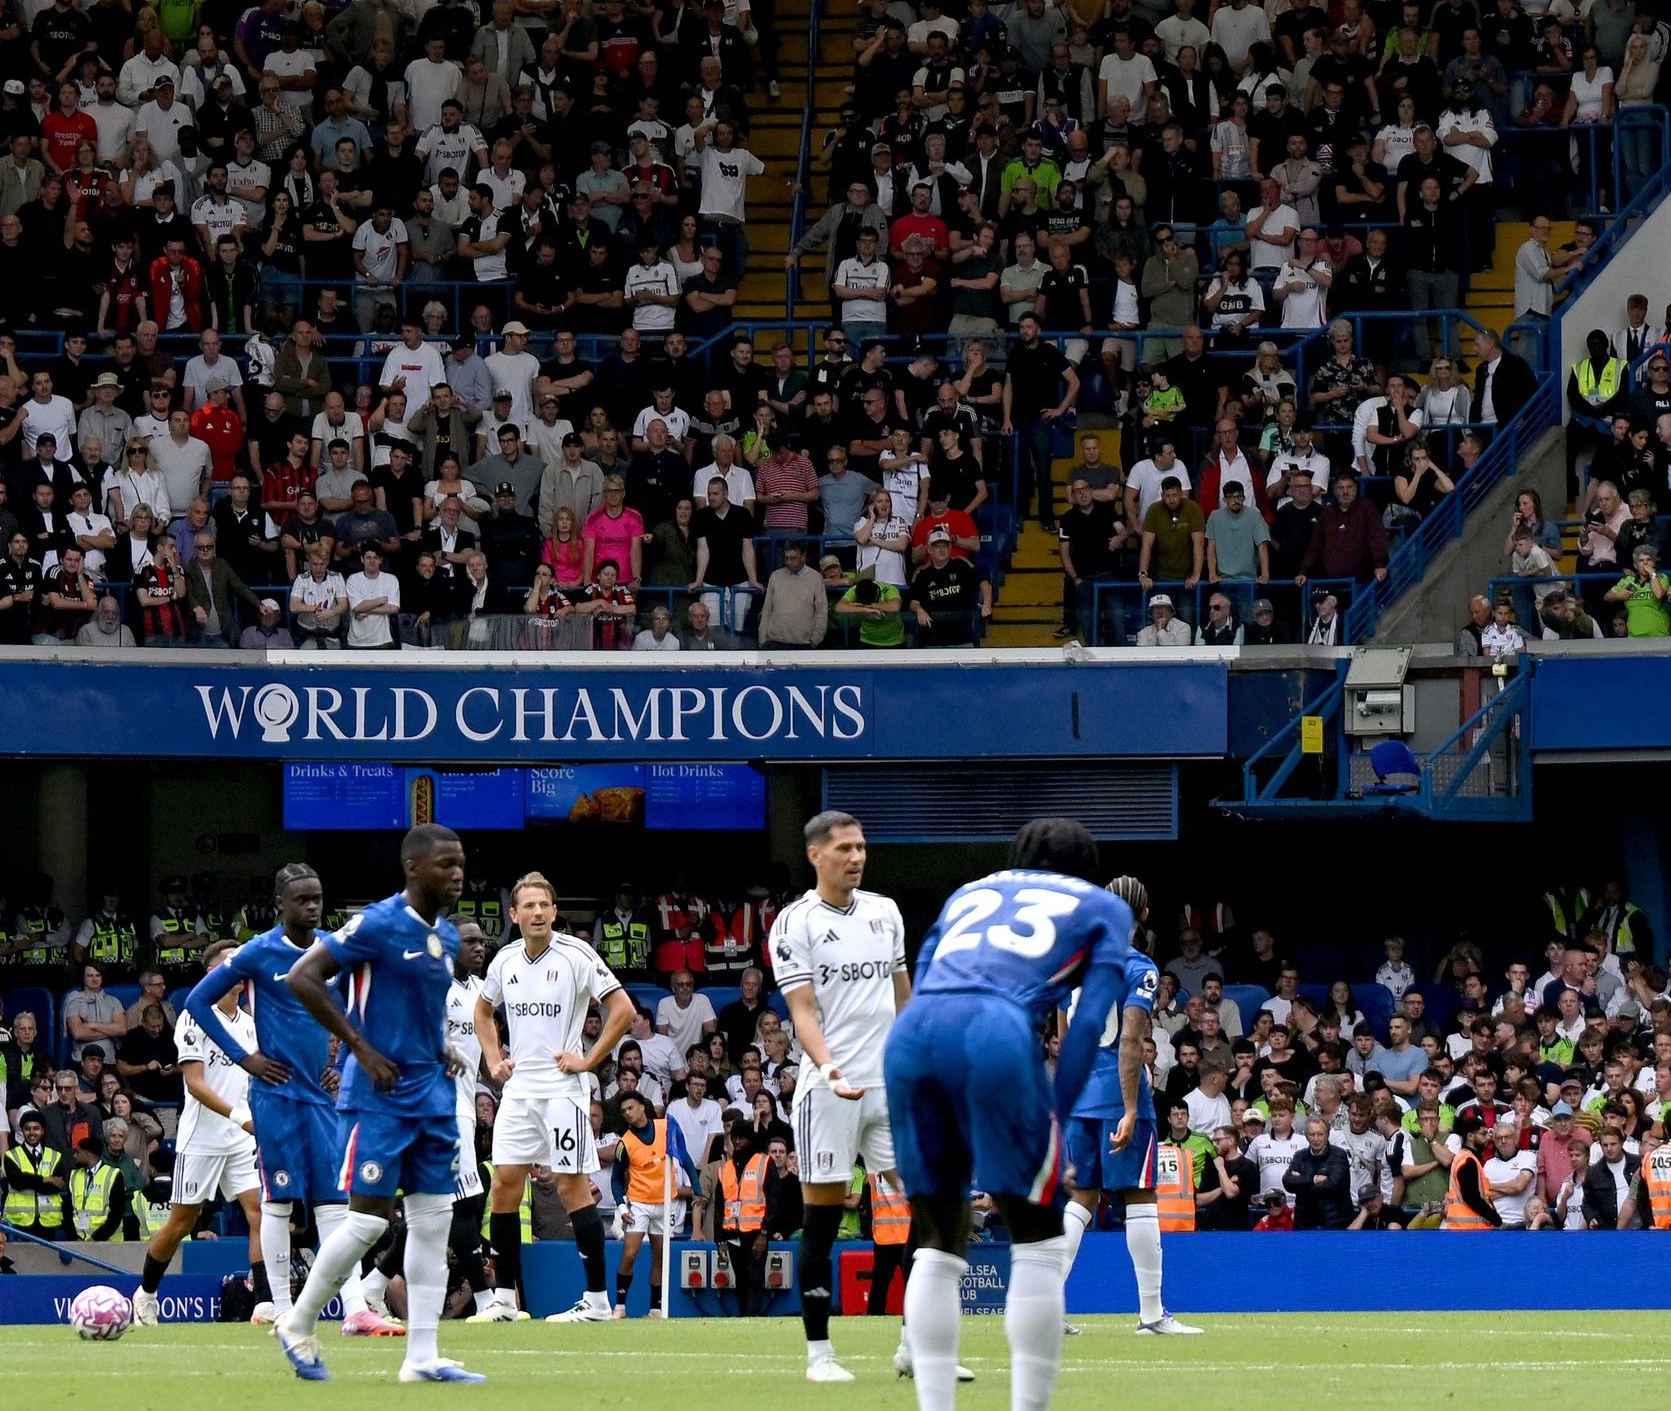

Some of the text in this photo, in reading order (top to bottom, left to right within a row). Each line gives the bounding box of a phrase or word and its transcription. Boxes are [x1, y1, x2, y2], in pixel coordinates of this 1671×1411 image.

[438, 148, 467, 160] SBOTOP
[1219, 299, 1245, 310] GMB
[455, 684, 866, 742] CHAMPIONS
[289, 764, 393, 778] Drinks & Treats
[530, 766, 575, 780] Score
[651, 764, 724, 778] Hot Drinks
[531, 779, 556, 798] Big
[932, 887, 1080, 960] 23
[841, 961, 891, 983] SBOTO
[514, 1001, 563, 1017] SBOTOP
[553, 1126, 576, 1151] 16
[964, 1264, 998, 1276] ELSEA
[958, 1277, 1005, 1288] OOTBALL
